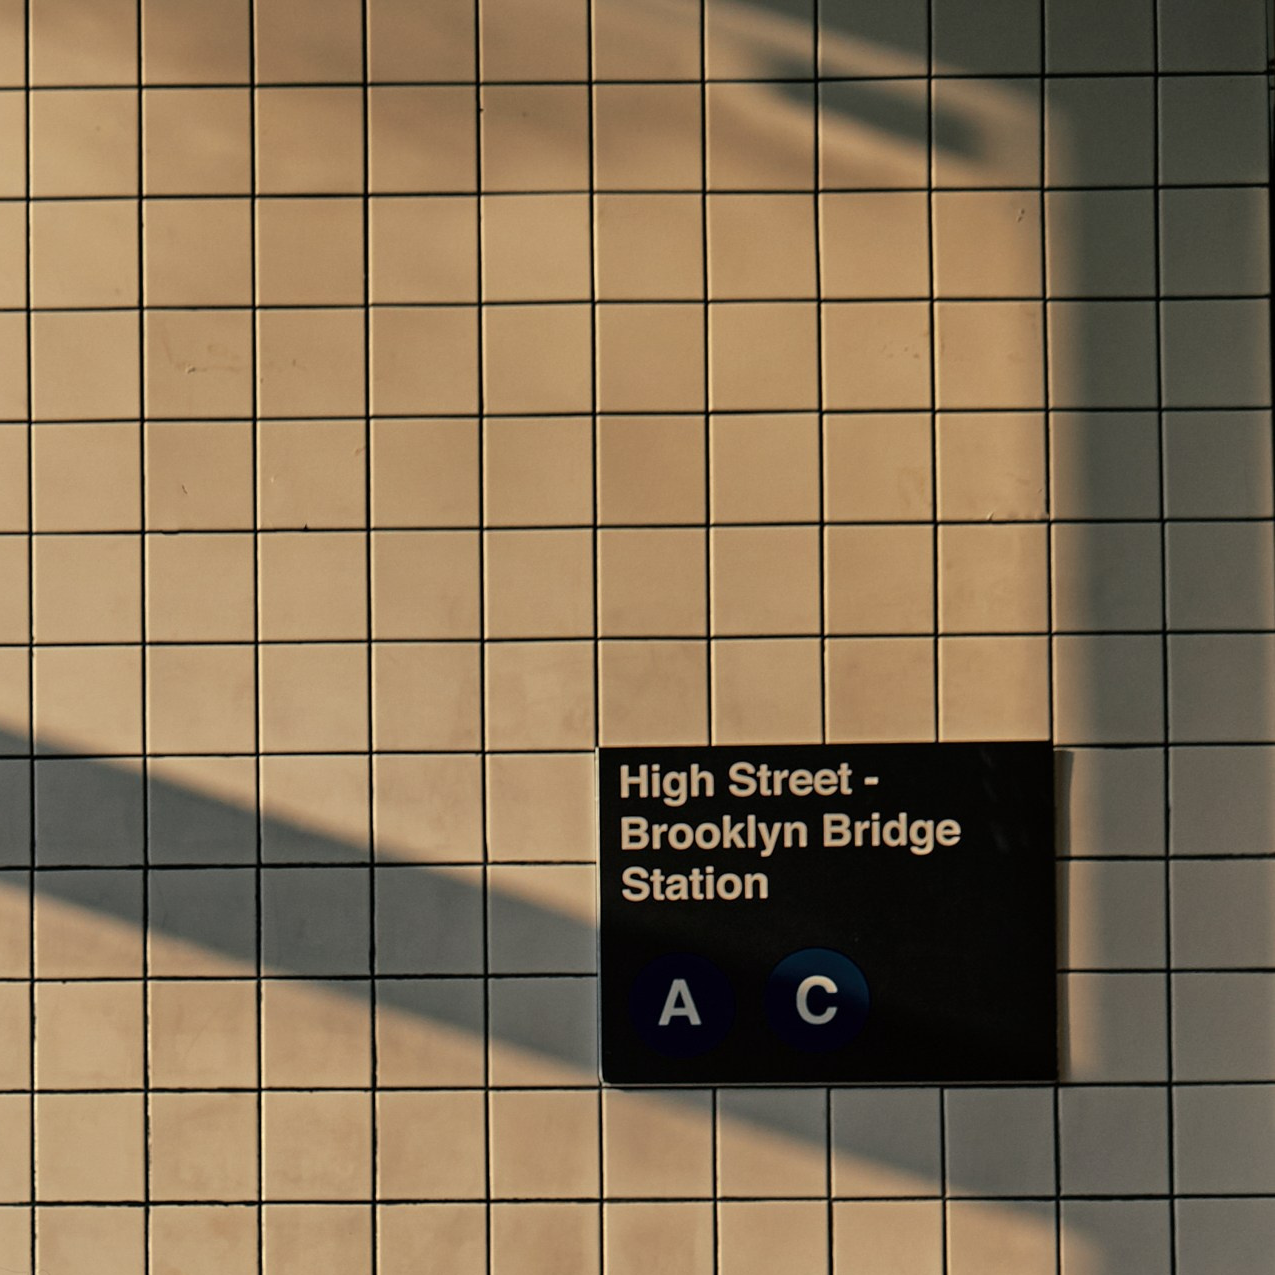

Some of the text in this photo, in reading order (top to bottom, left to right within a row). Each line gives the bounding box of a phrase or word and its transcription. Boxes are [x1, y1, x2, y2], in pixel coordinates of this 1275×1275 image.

[620, 762, 879, 807] High Street -
[620, 812, 962, 857] Brooklyn Bridge
[621, 865, 769, 902] Station
[658, 975, 838, 1026] A C
